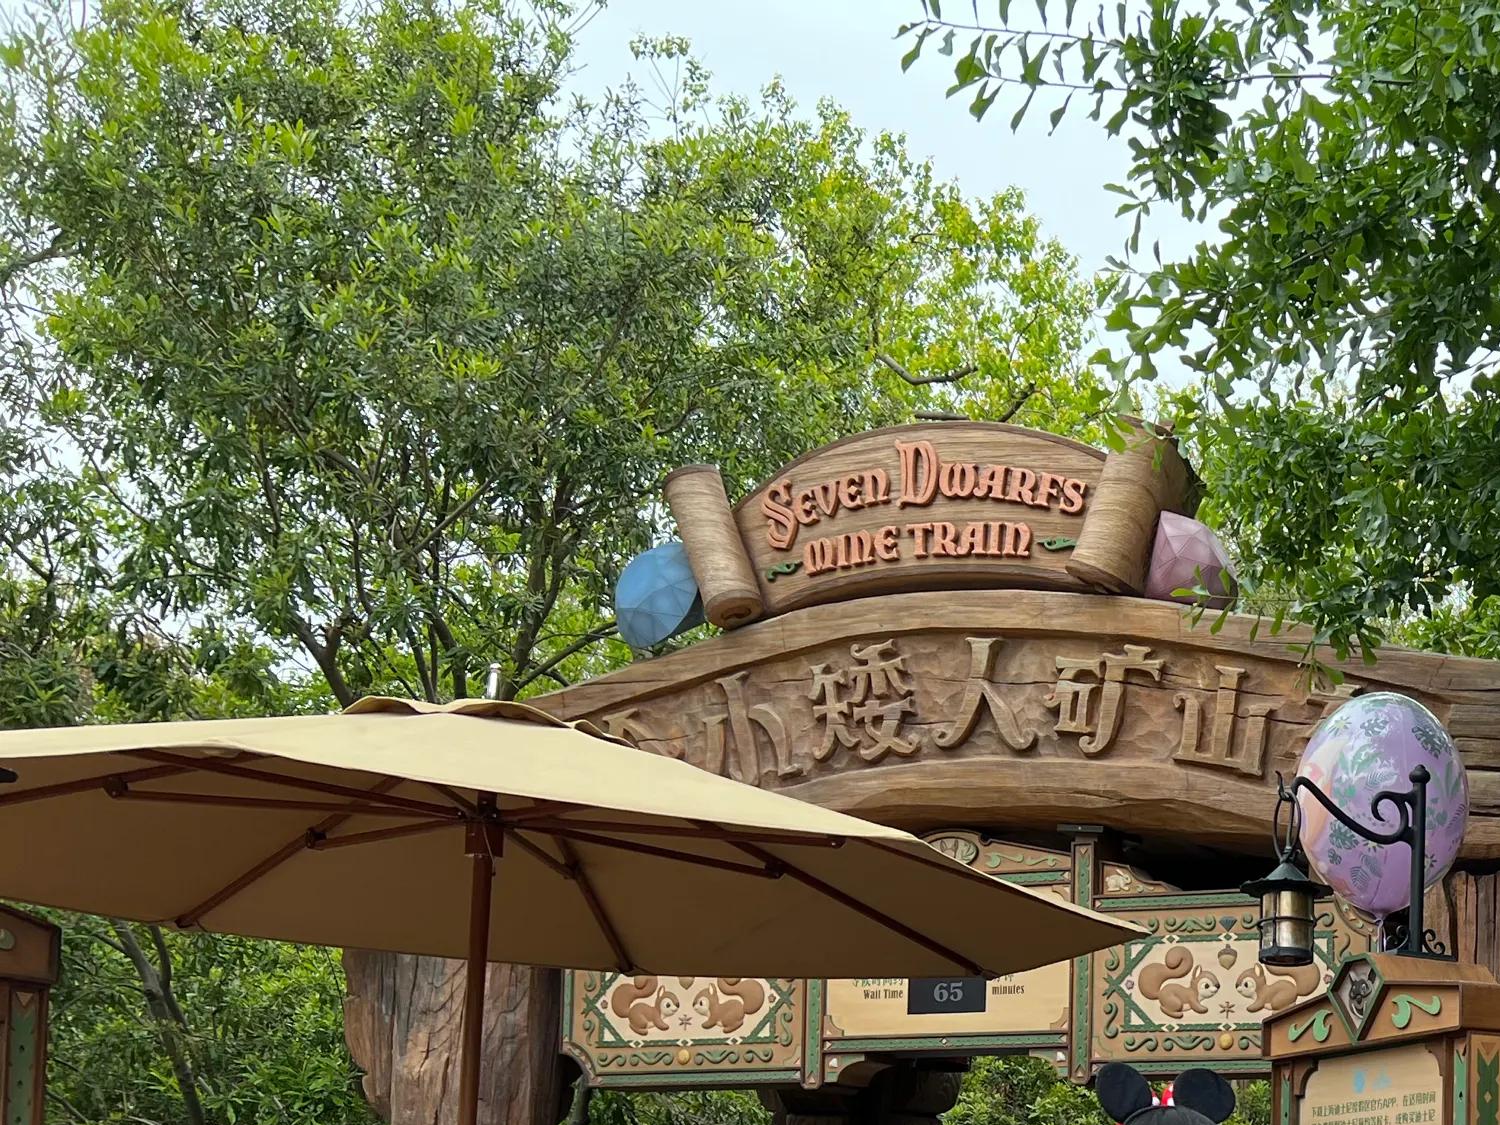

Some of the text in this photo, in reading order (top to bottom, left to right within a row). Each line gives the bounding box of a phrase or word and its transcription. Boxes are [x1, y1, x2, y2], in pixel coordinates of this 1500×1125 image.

[801, 521, 1033, 576] MINE TRAIN
[863, 988, 904, 1000] Wait Time
[933, 981, 963, 1002] 65
[991, 984, 1025, 996] minutes
